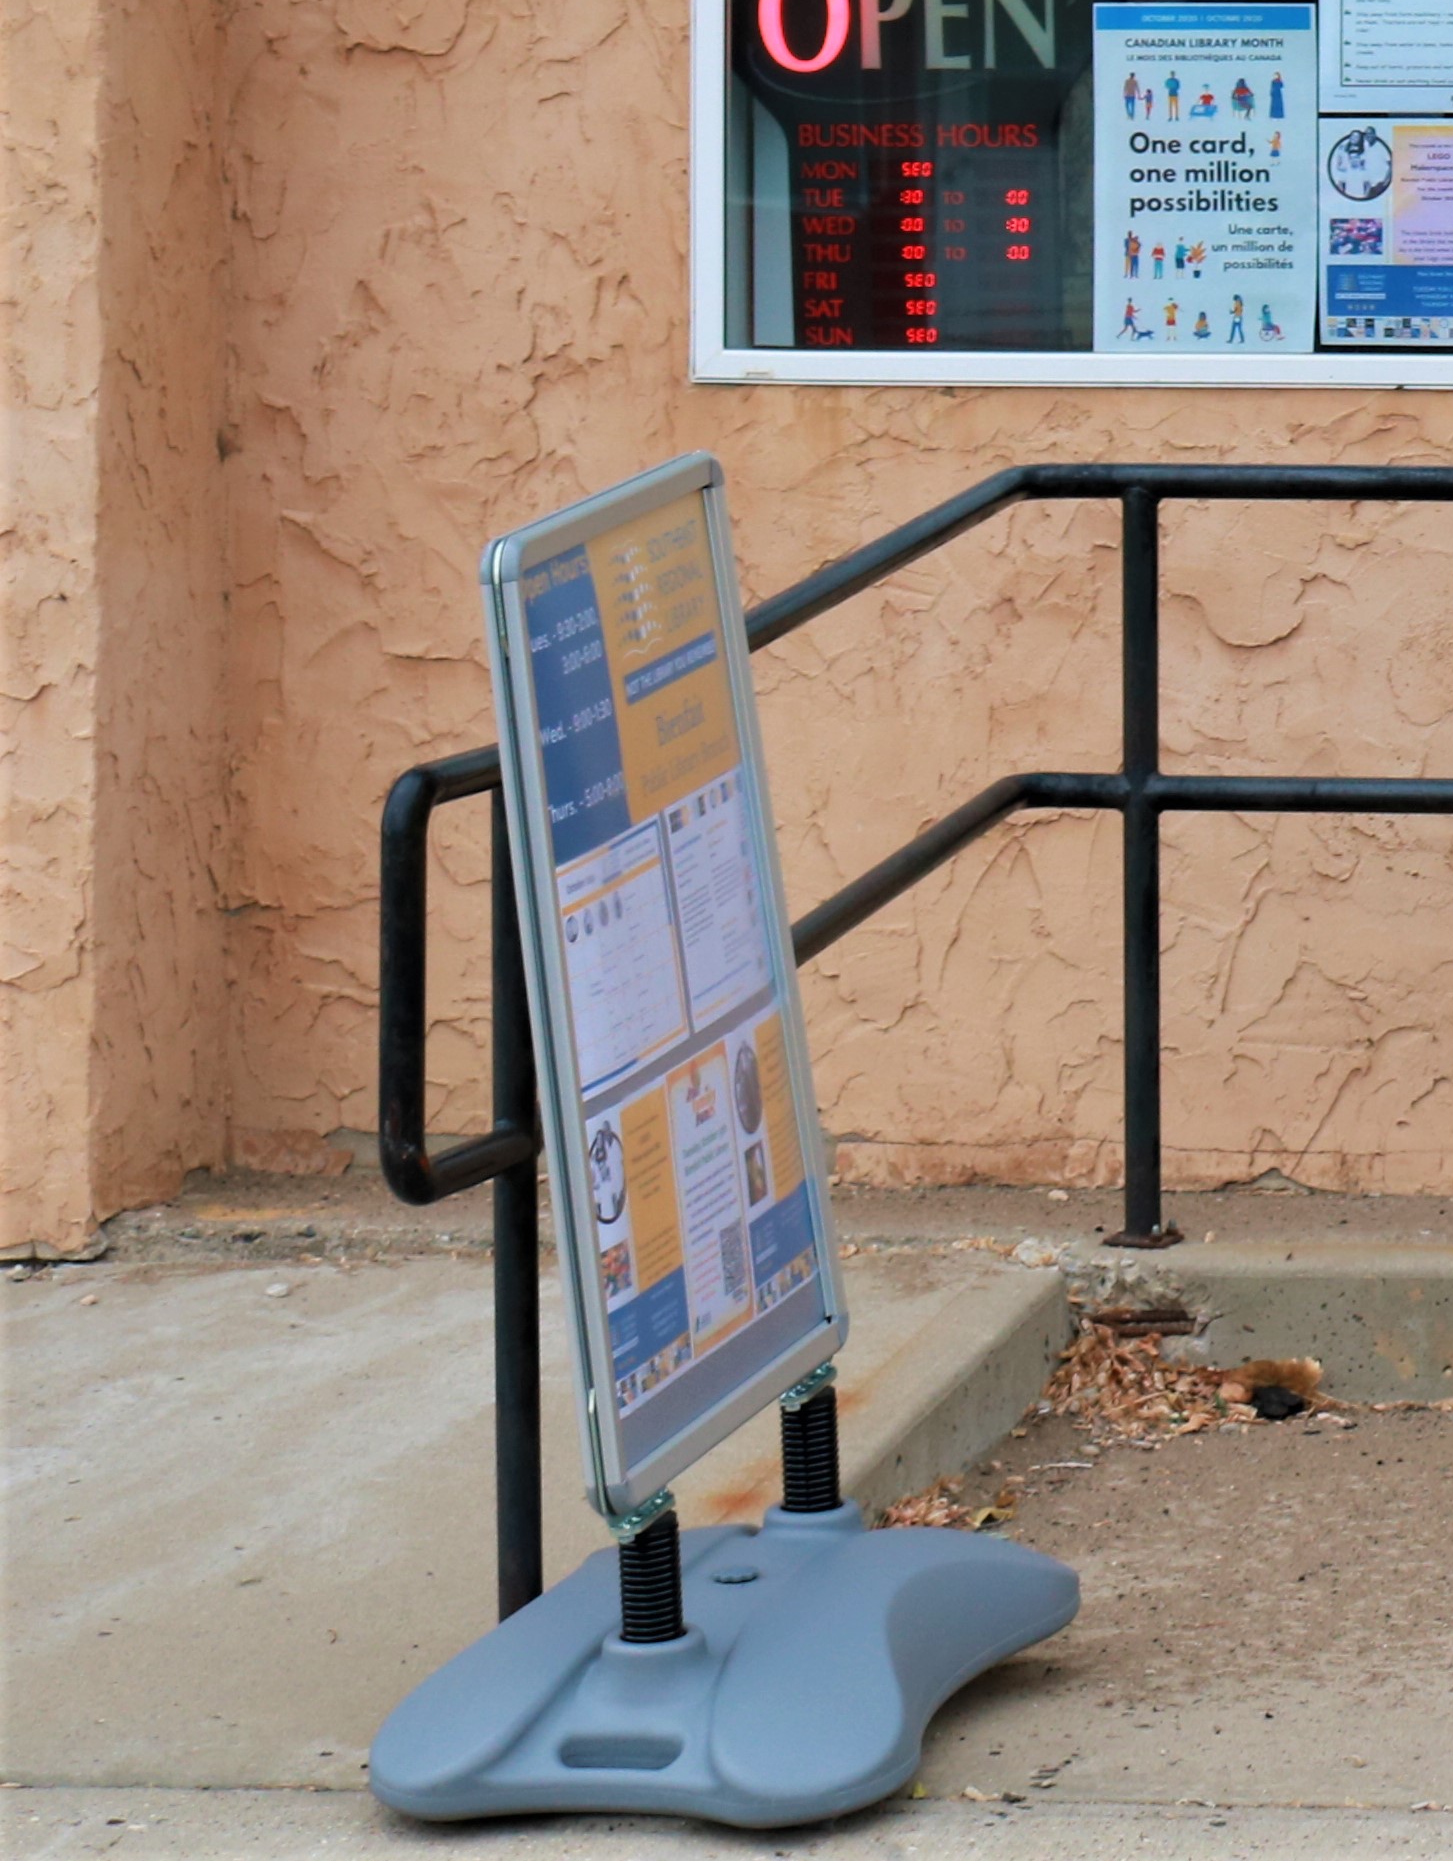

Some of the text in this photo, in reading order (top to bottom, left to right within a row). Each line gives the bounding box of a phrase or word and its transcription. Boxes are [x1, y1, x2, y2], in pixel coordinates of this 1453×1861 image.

[1125, 39, 1284, 48] CANADIAN LIBRARY MONTH
[799, 123, 1039, 148] BUSINESS HOURS
[1130, 132, 1255, 156] One card,
[801, 162, 857, 179] MON
[1130, 160, 1270, 183] one million
[804, 189, 844, 207] TUE
[1130, 190, 1278, 217] possibilities
[804, 217, 856, 234] WED
[1228, 224, 1294, 236] Une carte,
[804, 244, 851, 262] THU
[1212, 241, 1293, 252] un million de
[1223, 258, 1294, 271] possibilités
[805, 273, 838, 290] FRI
[805, 300, 844, 317] SAT
[805, 328, 853, 345] SUN
